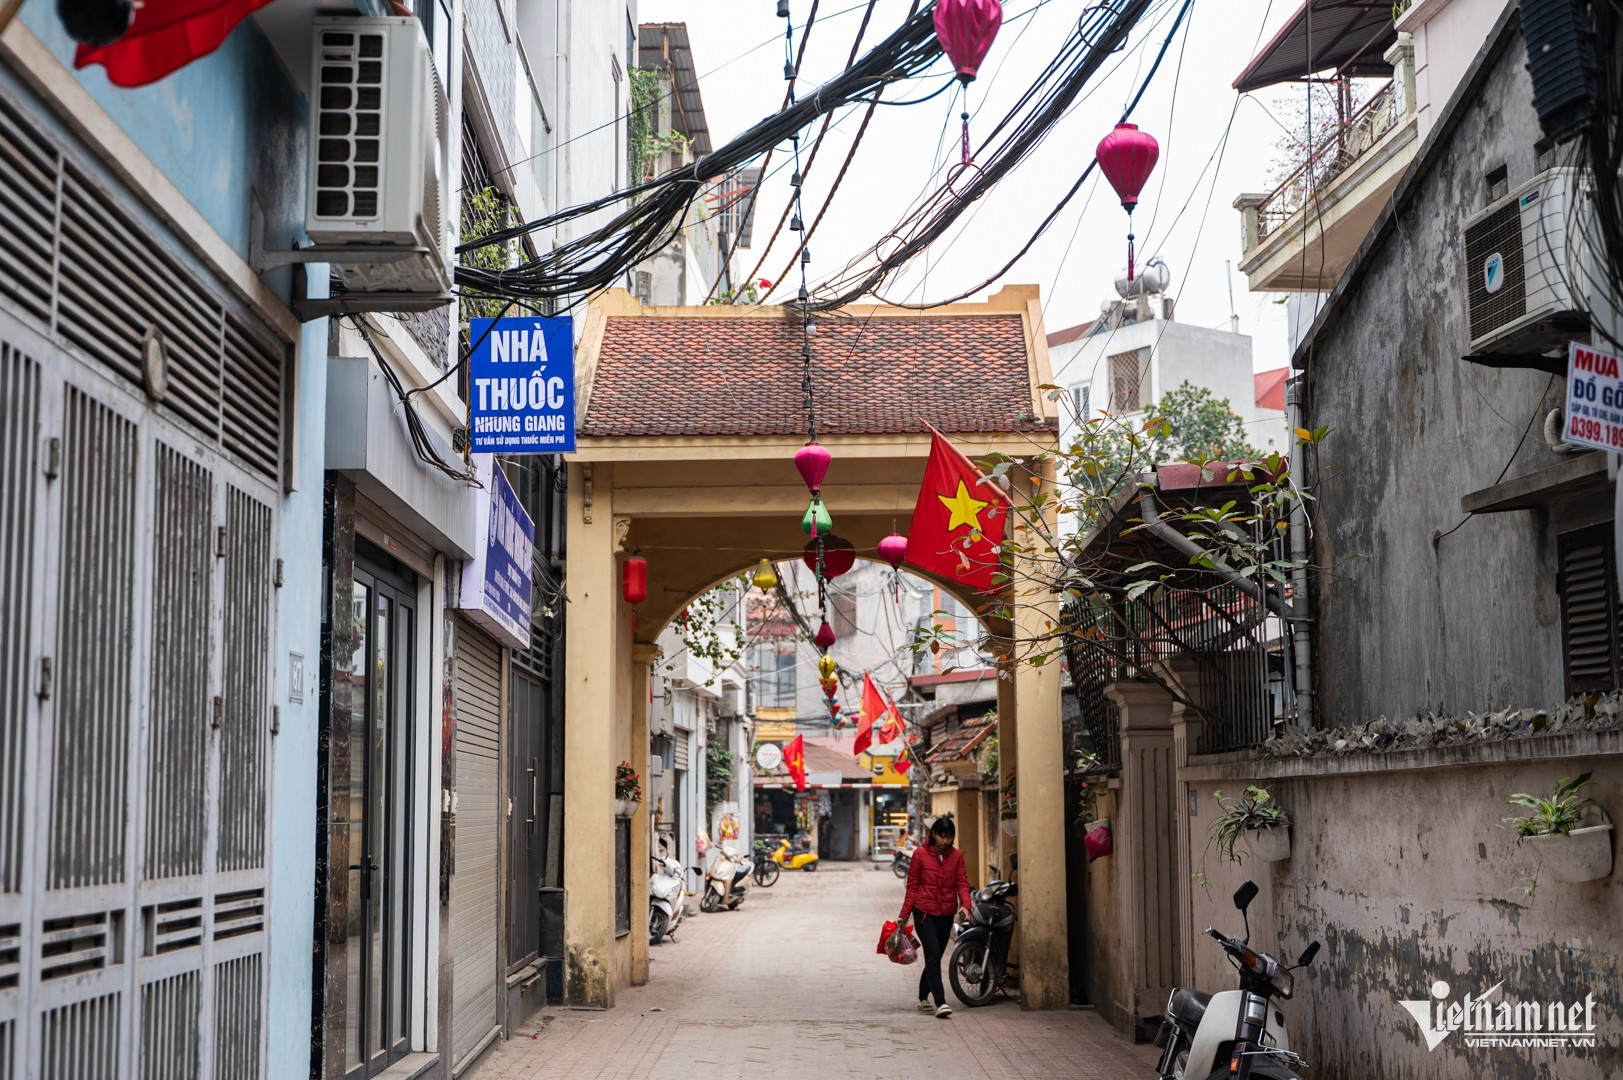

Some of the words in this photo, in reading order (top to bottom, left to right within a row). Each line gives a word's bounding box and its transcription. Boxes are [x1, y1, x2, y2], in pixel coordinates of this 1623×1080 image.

[490, 322, 548, 363] NHÀ
[1574, 348, 1619, 379] MUA
[475, 365, 565, 411] THUỐC
[475, 416, 521, 433] NHUNG
[524, 414, 565, 432] GIANG
[521, 434, 538, 445] THUỐC
[292, 661, 302, 691] 87
